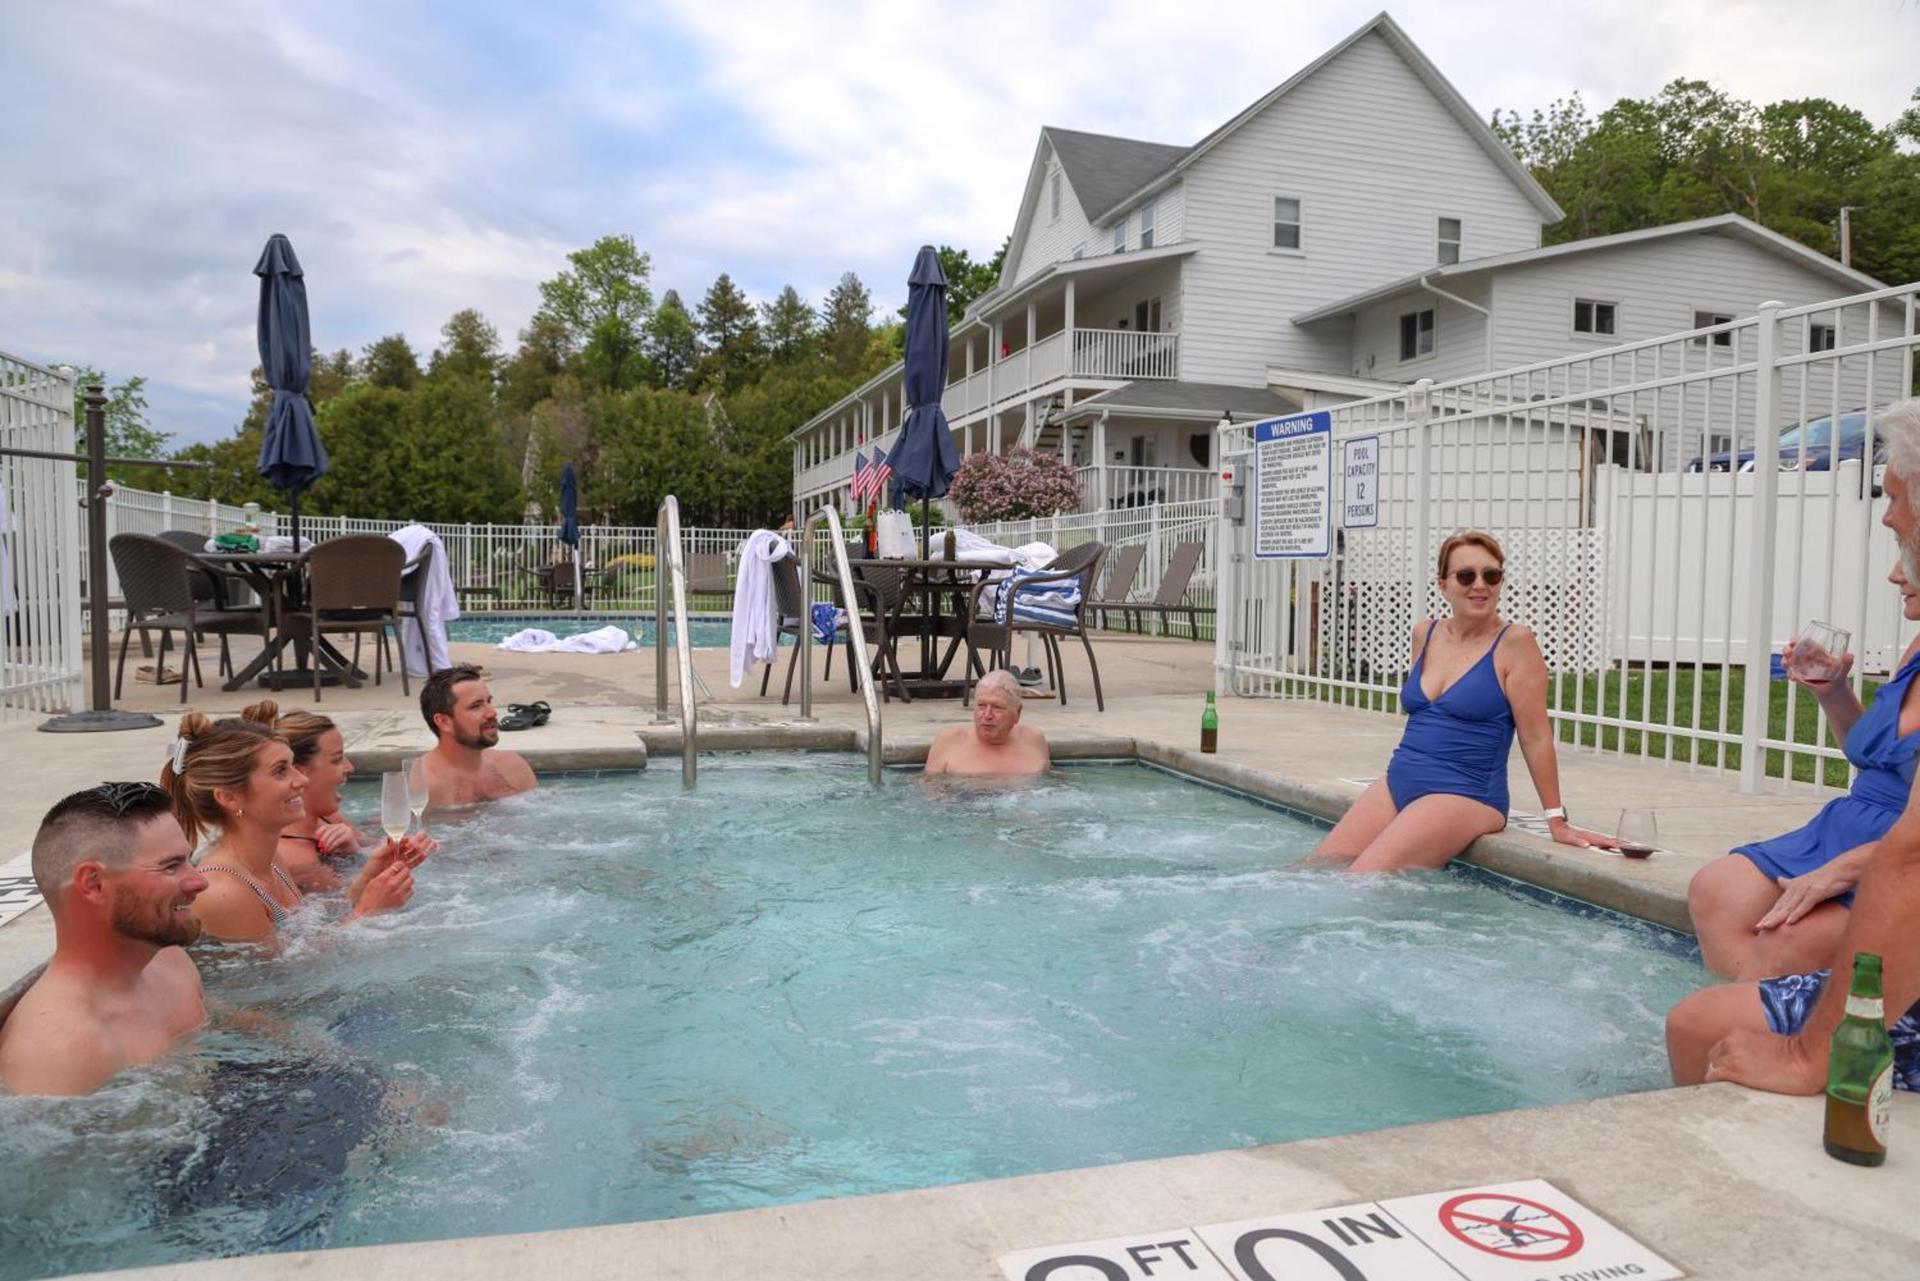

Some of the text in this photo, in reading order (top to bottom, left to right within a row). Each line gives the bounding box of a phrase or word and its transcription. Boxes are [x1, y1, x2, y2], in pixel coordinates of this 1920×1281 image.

[1271, 417, 1313, 438] WARNING
[1354, 447, 1369, 460] POOL
[1347, 462, 1375, 478] CAPACITY
[1357, 482, 1366, 500] 12
[1347, 503, 1374, 517] PERSONS
[1126, 1239, 1199, 1277] FT
[1322, 1212, 1403, 1247] IN
[1559, 1263, 1646, 1281] DIVING
